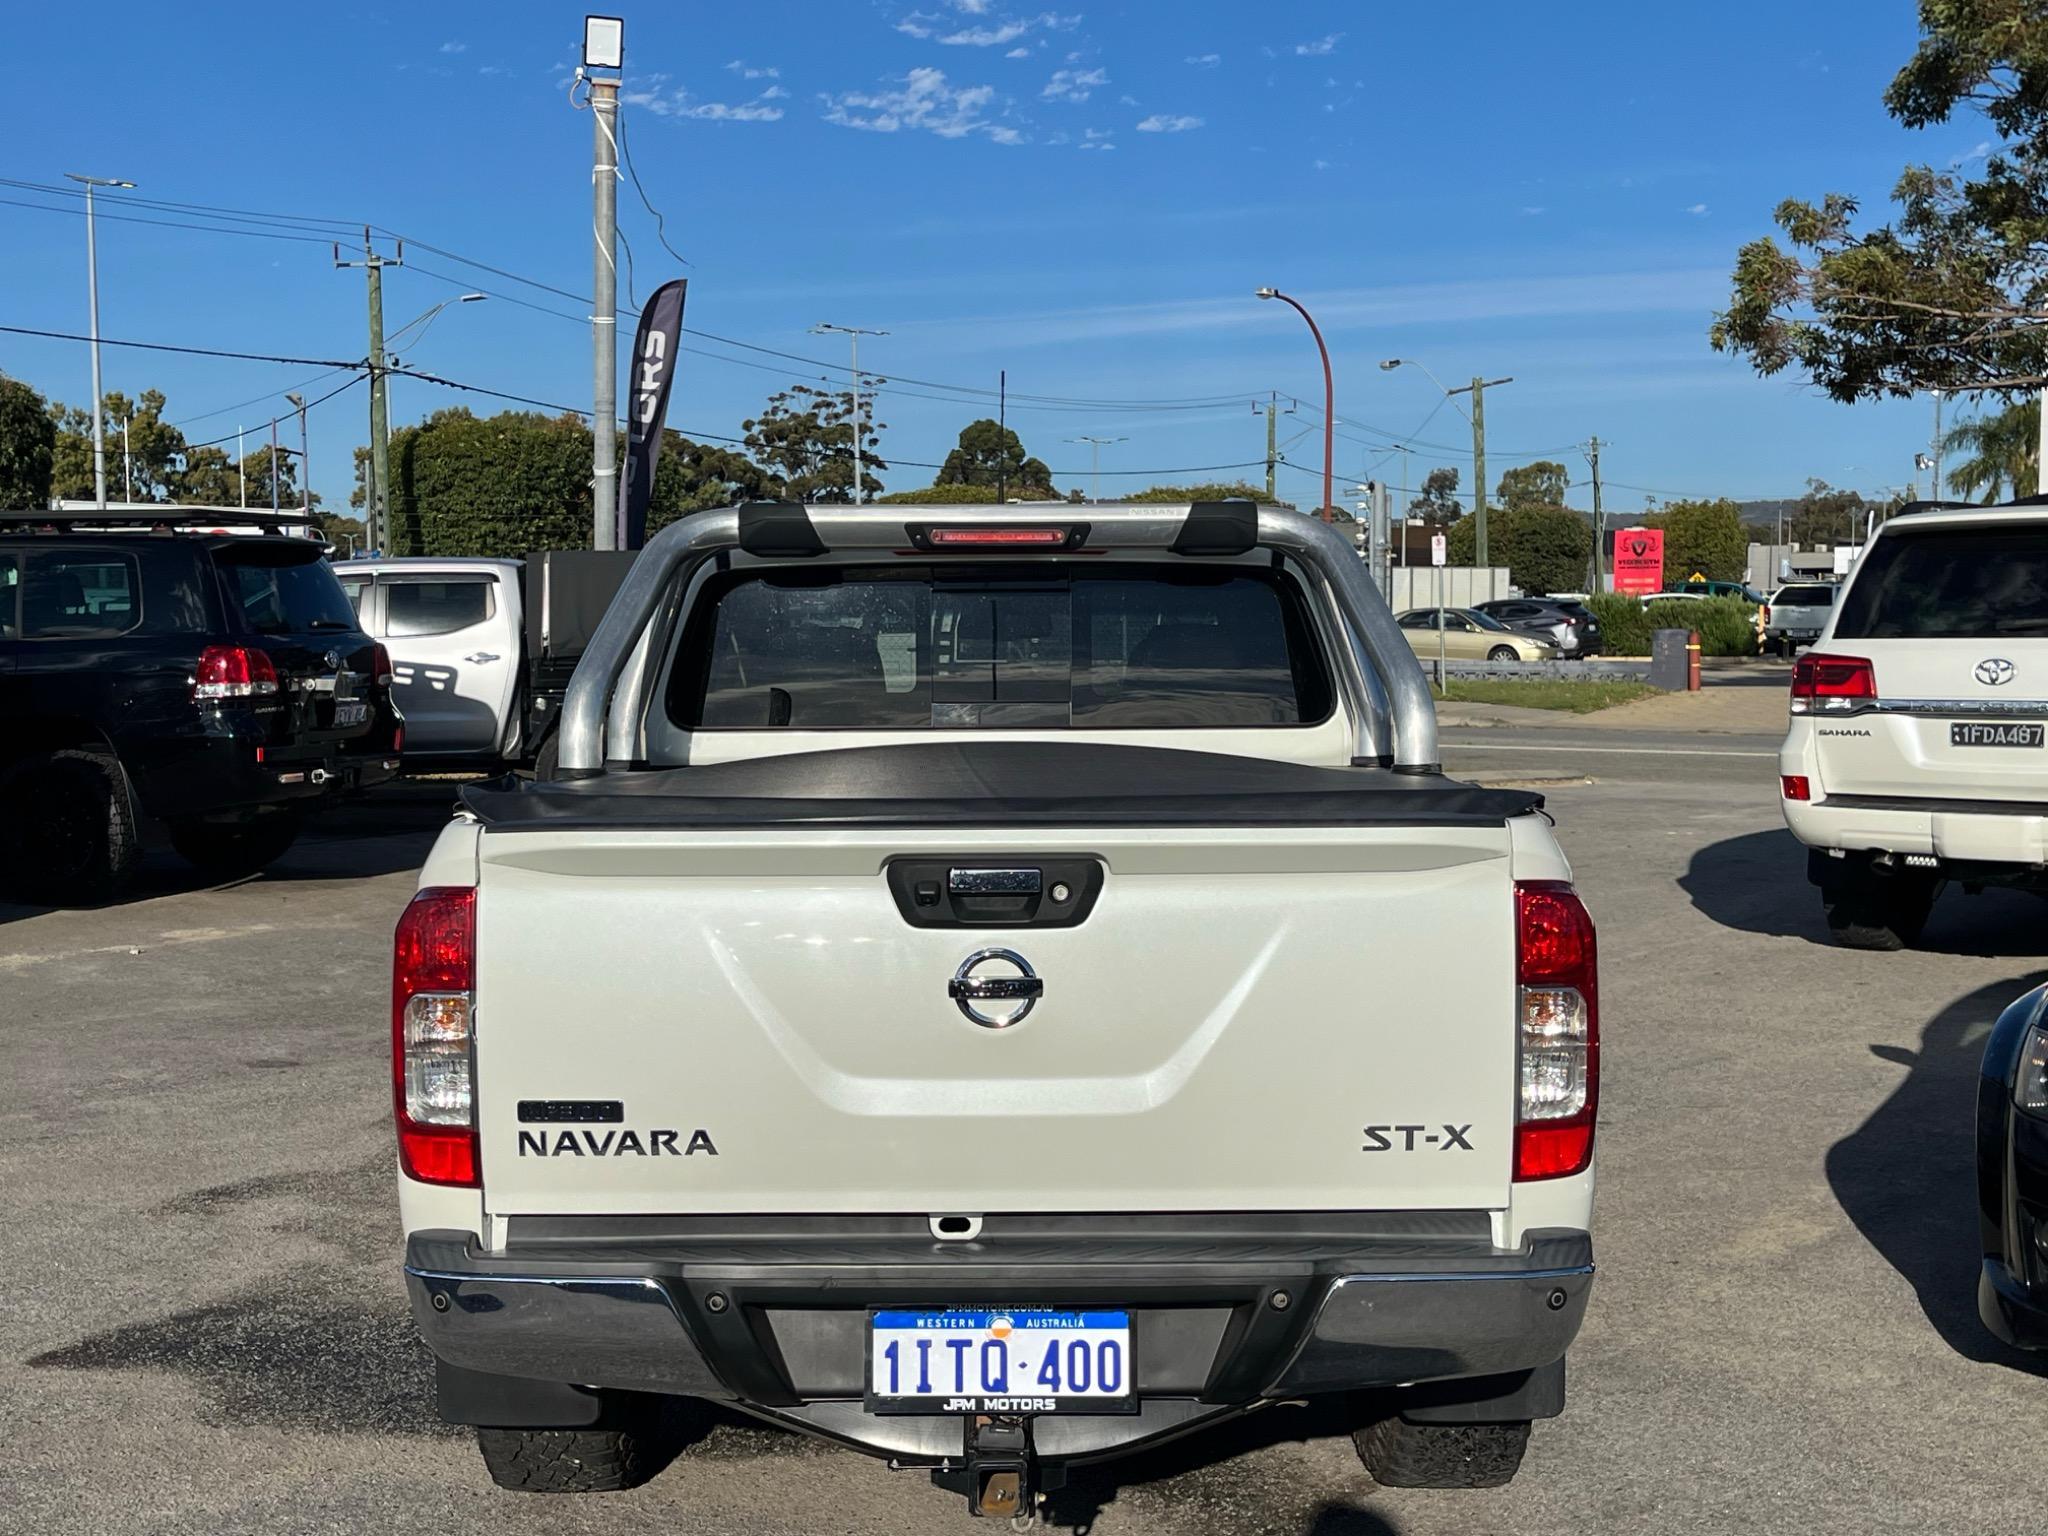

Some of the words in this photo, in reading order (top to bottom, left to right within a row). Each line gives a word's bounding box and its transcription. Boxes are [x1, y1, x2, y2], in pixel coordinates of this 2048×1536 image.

[1818, 729, 1872, 737] SAHARA
[518, 1129, 719, 1156] NAVARA
[1362, 1124, 1474, 1151] ST-X
[916, 1318, 975, 1328] WESTERN
[1026, 1317, 1085, 1328] AUSTRALIA
[943, 1398, 976, 1410] JPM
[984, 1398, 1056, 1410] MOTORS
